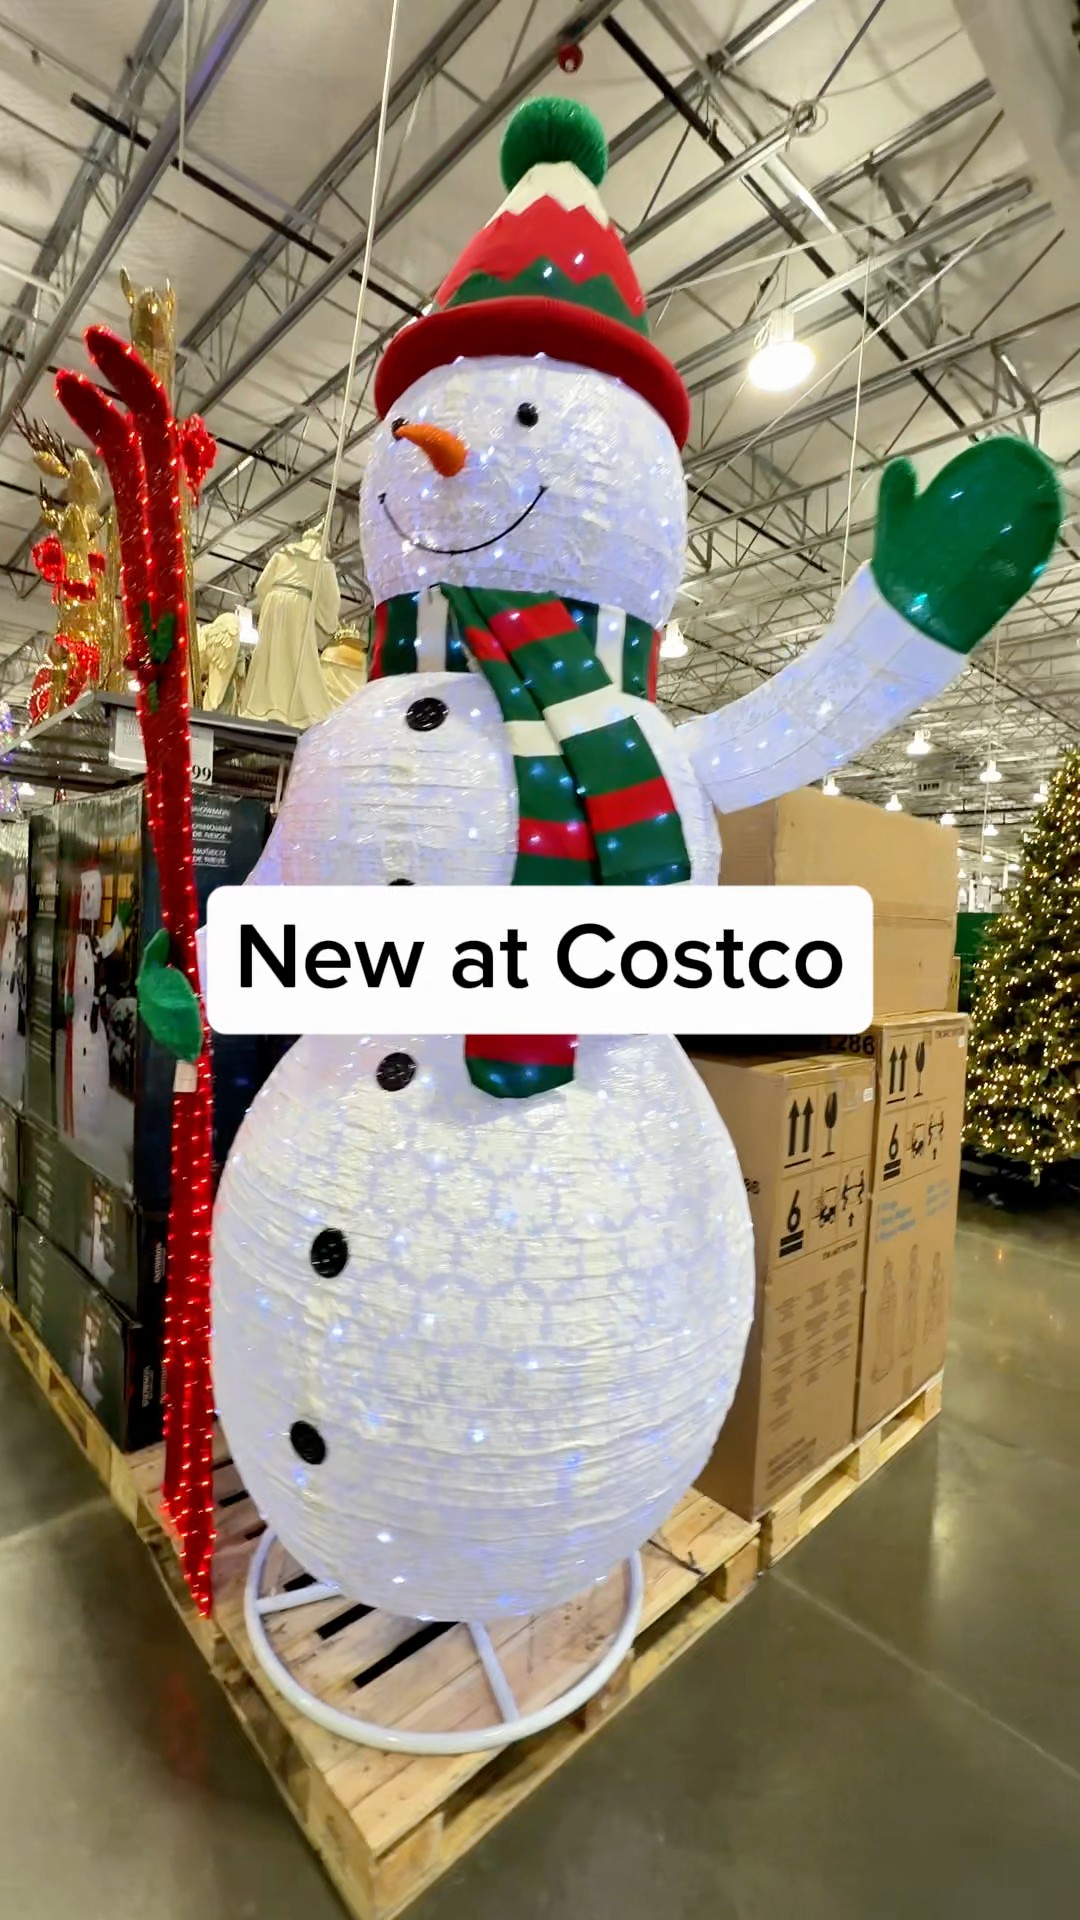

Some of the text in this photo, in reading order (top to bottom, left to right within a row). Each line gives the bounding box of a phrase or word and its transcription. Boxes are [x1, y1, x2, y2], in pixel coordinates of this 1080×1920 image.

[192, 764, 212, 781] 99
[888, 1123, 900, 1160] 6
[787, 1189, 802, 1233] 6
